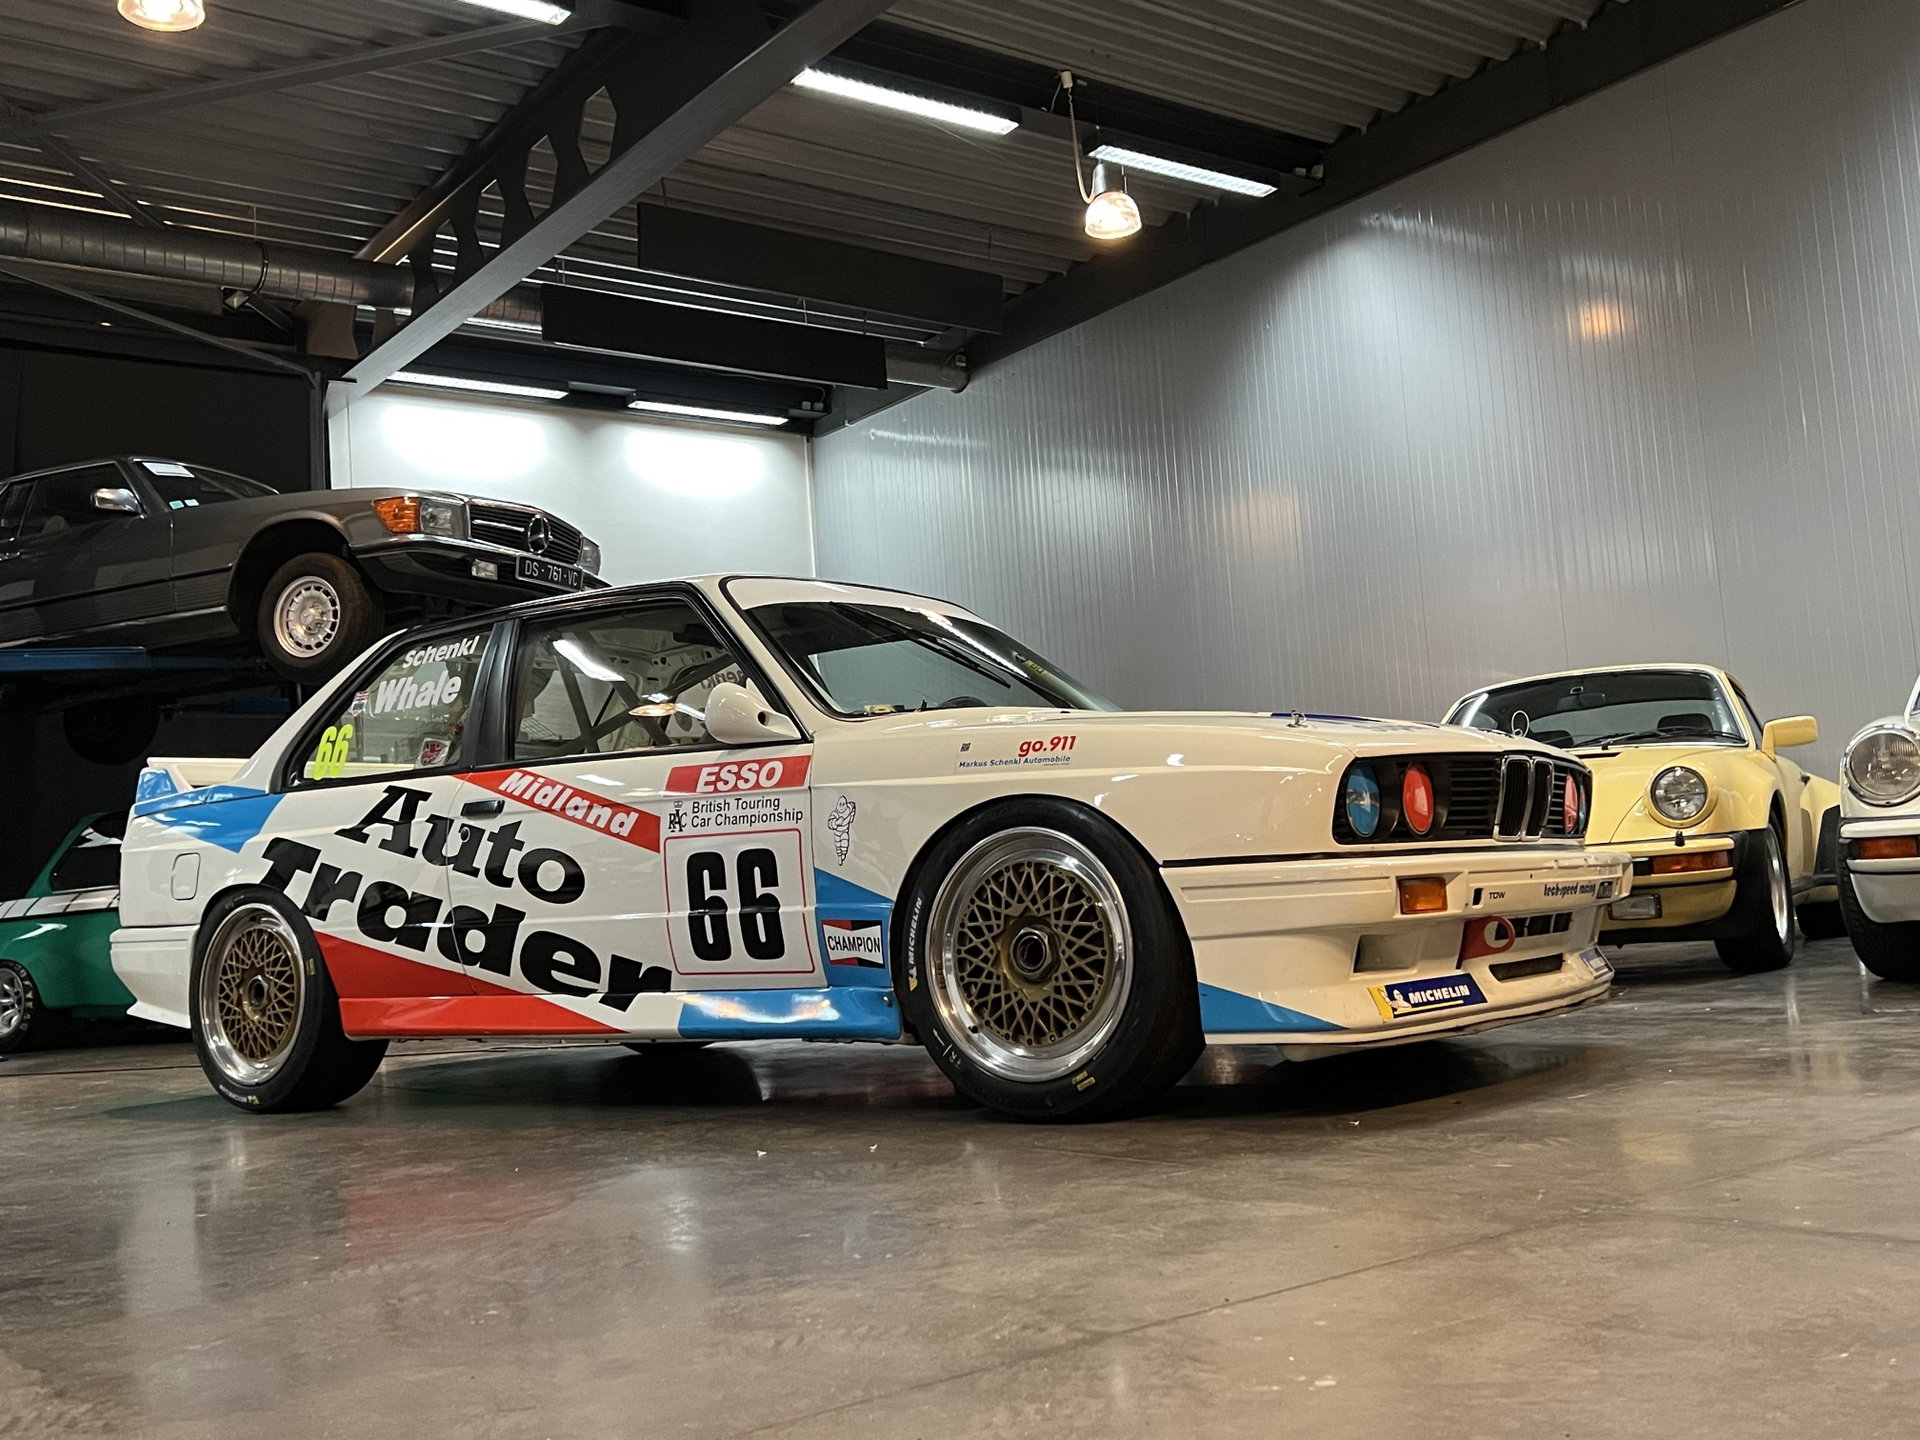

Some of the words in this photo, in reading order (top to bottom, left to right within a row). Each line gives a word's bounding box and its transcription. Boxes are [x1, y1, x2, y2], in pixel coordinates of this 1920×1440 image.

[402, 635, 480, 668] Schenkl
[375, 671, 461, 713] Whale
[313, 724, 353, 780] 66
[959, 760, 987, 768] Markus
[990, 758, 1021, 767] Schenkl
[1023, 755, 1071, 764] Automobile
[1018, 736, 1077, 757] go.911
[696, 760, 784, 793] ESSO
[498, 771, 639, 838] Midland
[691, 815, 711, 828] Car
[715, 808, 804, 827] Championship
[692, 799, 730, 814] British
[734, 796, 780, 812] Touring
[334, 785, 586, 904] Auto
[686, 848, 785, 962] 66
[1489, 891, 1506, 900] TOW
[261, 837, 672, 1012] Trader
[908, 897, 923, 965] MICHELIN
[827, 936, 881, 953] CHAMPION
[1409, 984, 1470, 1004] MICHELIN
